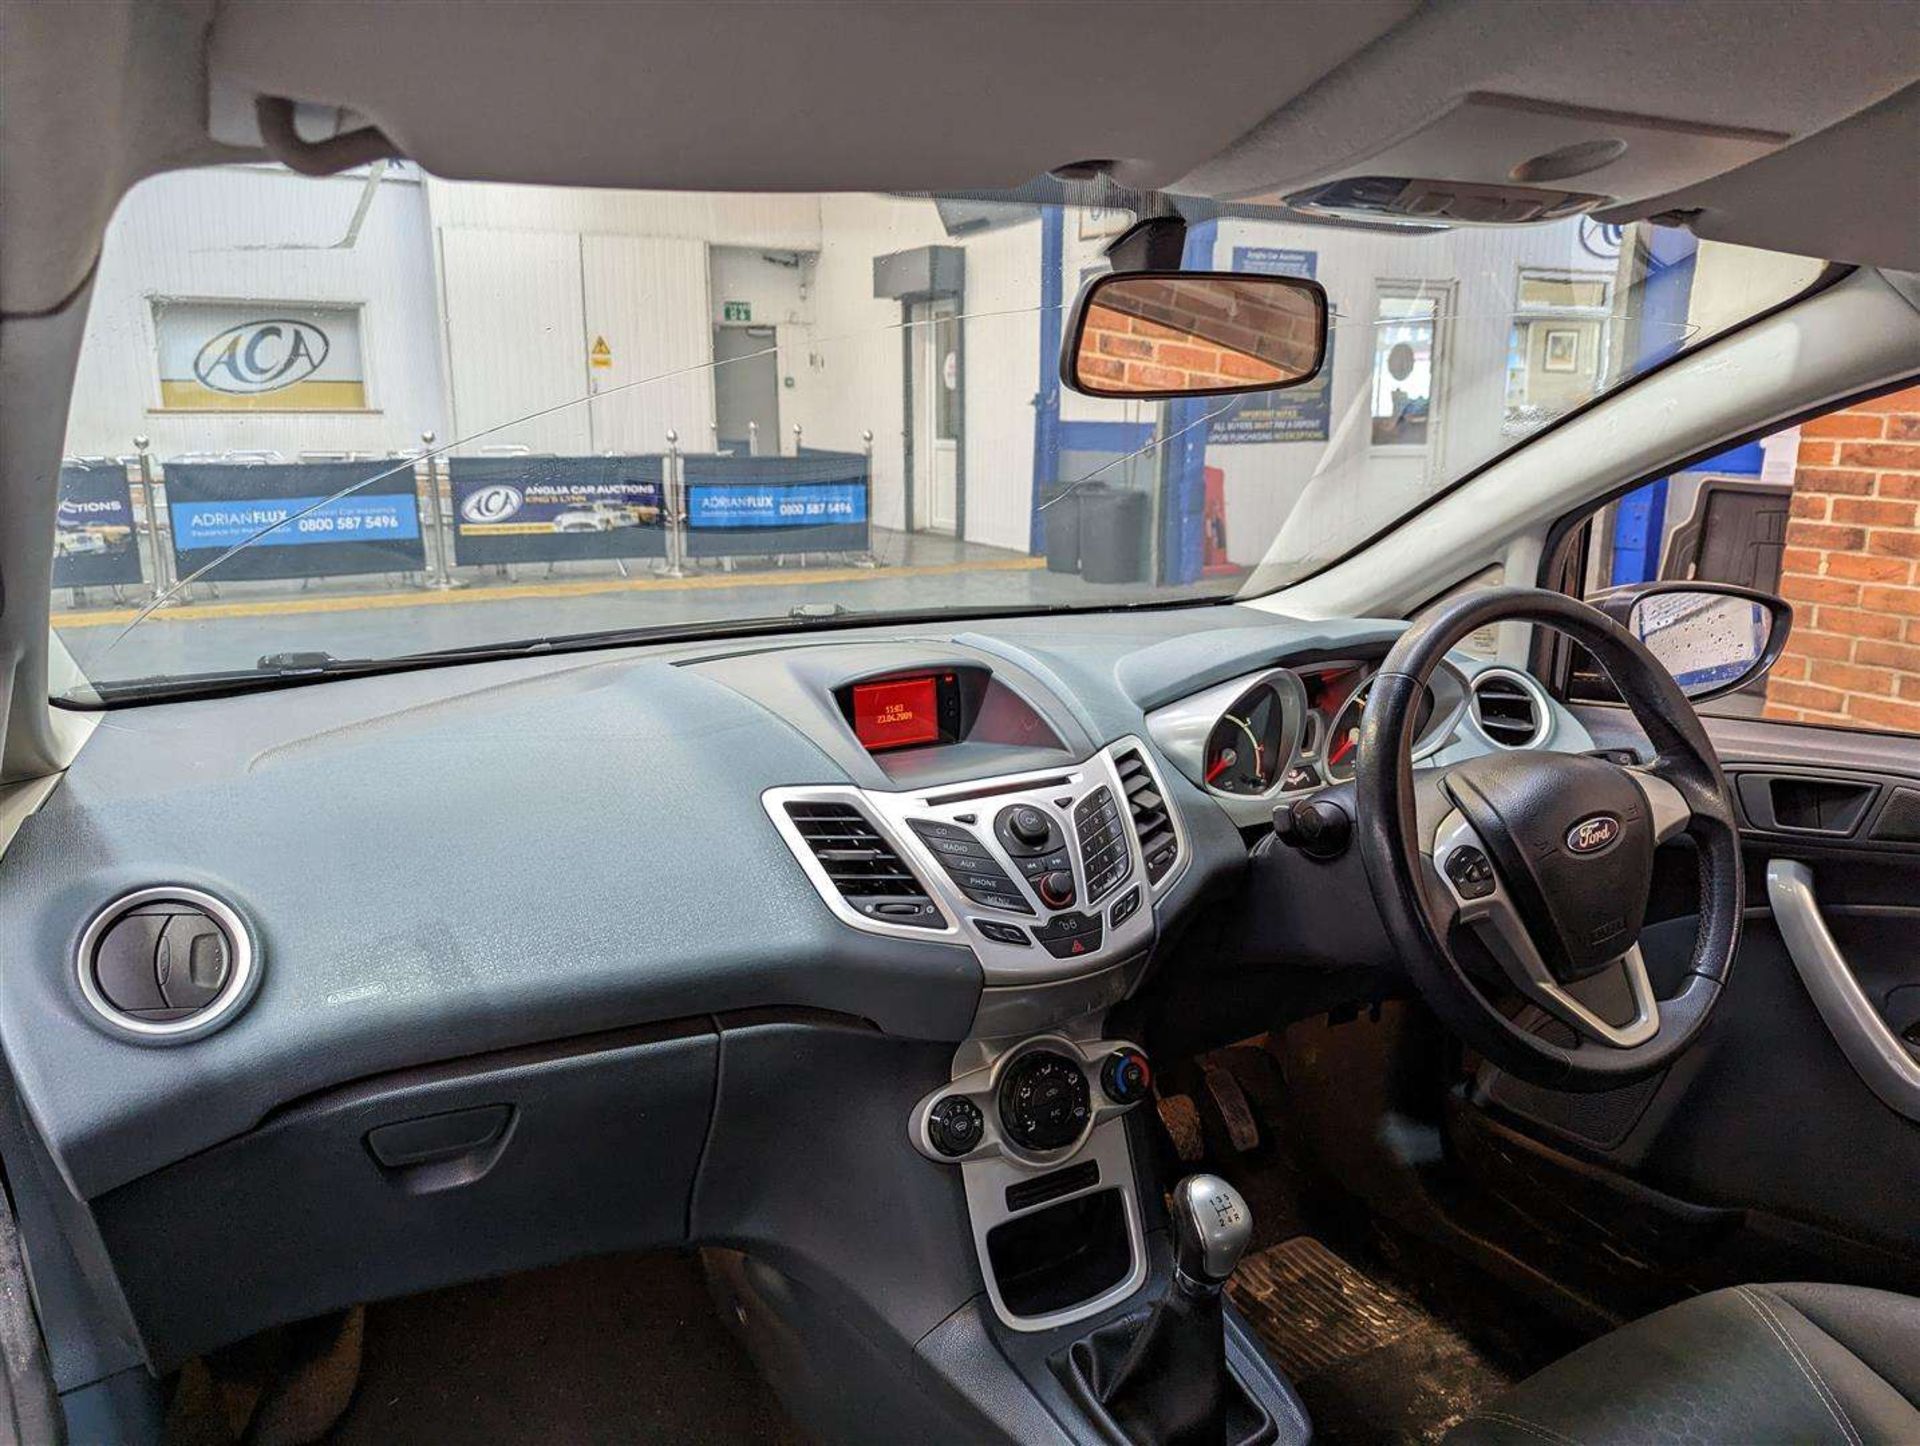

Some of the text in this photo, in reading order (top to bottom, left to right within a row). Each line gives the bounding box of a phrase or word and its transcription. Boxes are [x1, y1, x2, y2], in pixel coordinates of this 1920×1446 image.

[201, 325, 317, 384] ACA
[525, 484, 655, 494] ANGLIA CAR AUCTIONS
[780, 503, 804, 516] 0800
[806, 502, 824, 514] 587
[298, 518, 333, 532] 0800
[337, 517, 360, 530] 587
[366, 515, 398, 529] 5496
[1579, 821, 1611, 848] Ford
[943, 844, 968, 853] RADIO
[960, 860, 976, 868] AUX
[970, 878, 997, 887] PHONE
